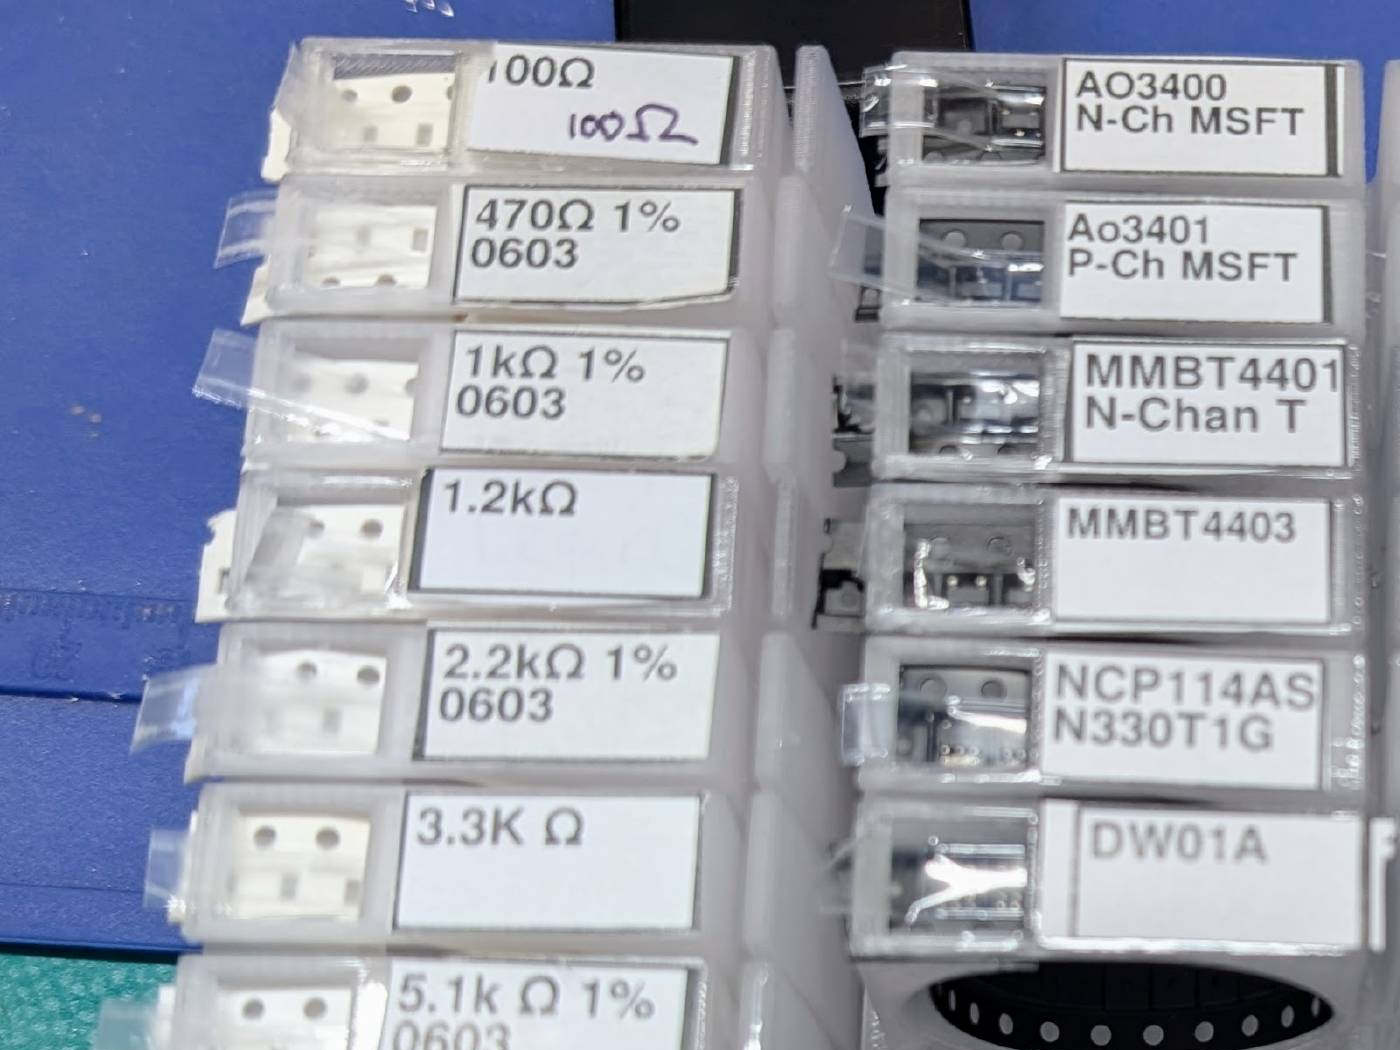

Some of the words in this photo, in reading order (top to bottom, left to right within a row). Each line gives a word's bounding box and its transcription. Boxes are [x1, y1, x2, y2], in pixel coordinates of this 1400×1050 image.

[1076, 70, 1226, 101] AO3400
[1077, 104, 1173, 133] N-Ch
[1191, 106, 1304, 135] MSFT
[476, 199, 594, 231] 470Ω
[615, 200, 680, 232] 1%
[1068, 213, 1207, 245] Ao3401
[470, 237, 577, 269] 0603
[1069, 247, 1164, 279] P-Ch
[1182, 251, 1297, 281] MSFT
[468, 345, 557, 379] 1kΩ
[580, 348, 645, 382] 1%
[1087, 353, 1337, 391] MMBT4401
[456, 385, 565, 420] 0603
[1086, 396, 1258, 432] N-Chan
[1276, 399, 1306, 432] T
[446, 480, 577, 516] 1.2kΩ
[1068, 507, 1295, 542] MMBT4403
[444, 644, 584, 680] 2.2kΩ
[607, 645, 677, 680] 1%
[439, 687, 552, 722] 0603
[1054, 663, 1316, 711] NCP114AS
[1053, 712, 1273, 752] N330T1G
[417, 807, 523, 846] 3.3K
[545, 807, 583, 845] Ω
[1091, 820, 1267, 863] DW01A
[399, 973, 498, 1014] 5.1k
[519, 975, 559, 1015] Ω
[583, 979, 654, 1019] 1%
